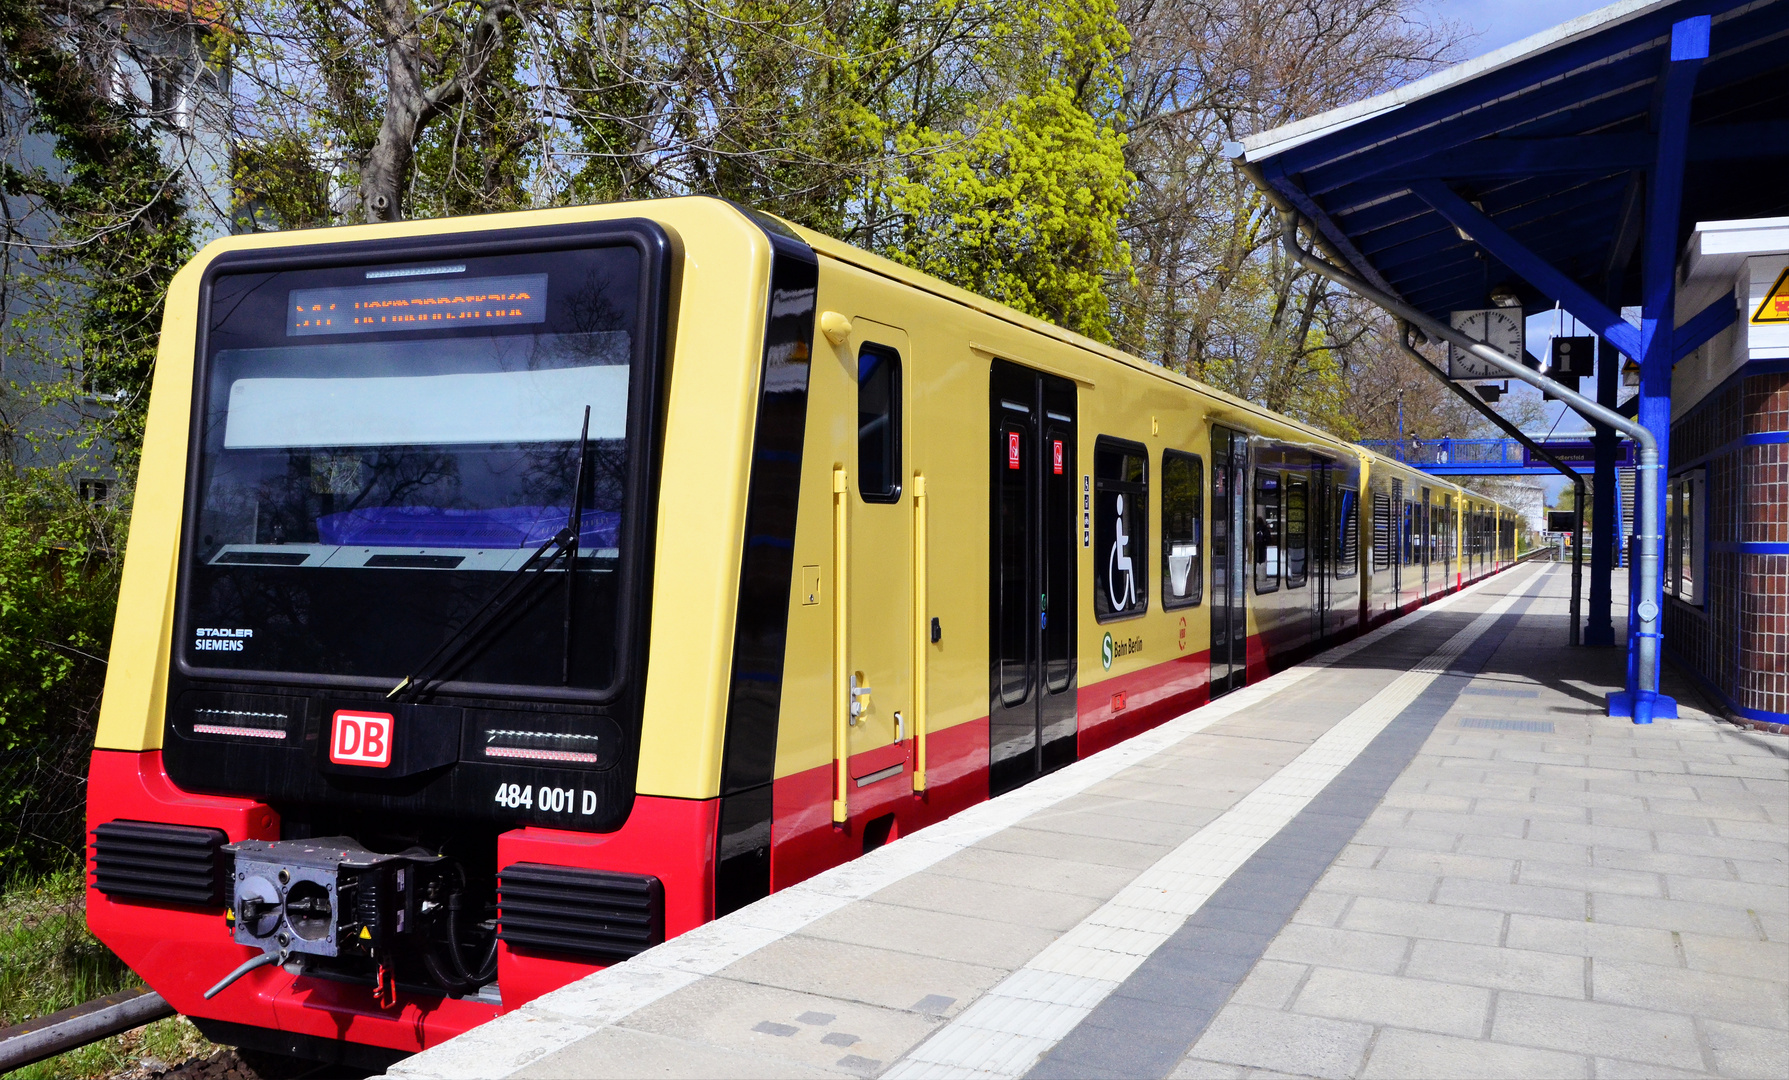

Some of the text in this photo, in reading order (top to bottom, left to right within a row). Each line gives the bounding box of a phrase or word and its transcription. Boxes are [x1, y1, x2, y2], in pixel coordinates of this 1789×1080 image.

[196, 628, 253, 638] STADLER
[195, 639, 244, 652] SIEMENS
[1114, 640, 1127, 658] Bahn
[1128, 635, 1143, 654] Berlin
[338, 719, 385, 758] DB
[495, 783, 597, 815] 484 001 D
